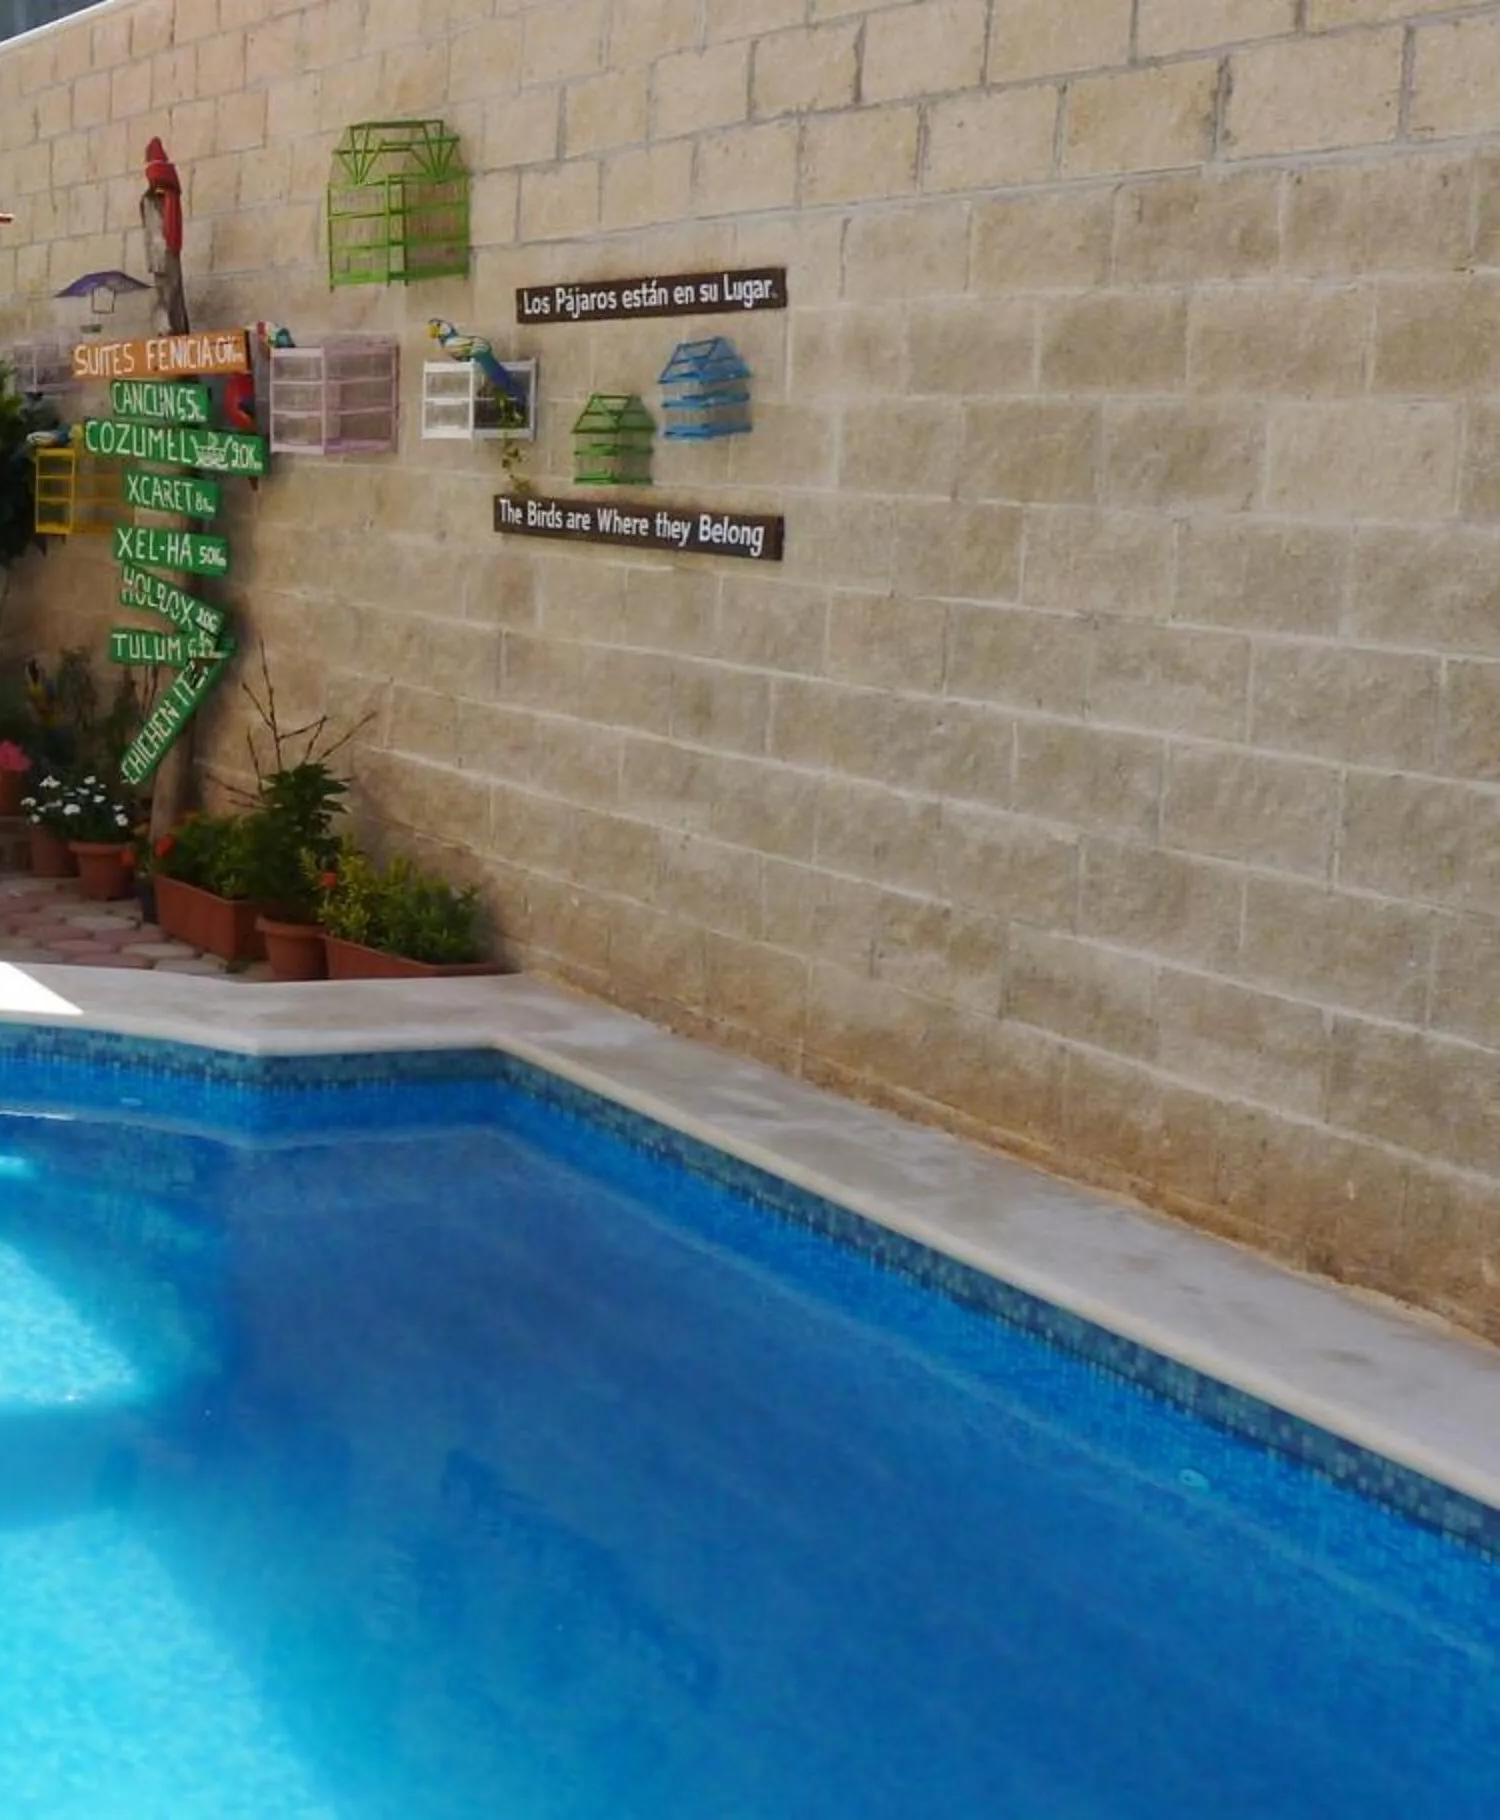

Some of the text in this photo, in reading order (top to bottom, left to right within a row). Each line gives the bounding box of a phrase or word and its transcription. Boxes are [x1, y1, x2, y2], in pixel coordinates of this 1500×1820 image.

[523, 290, 550, 315] Los
[554, 285, 617, 318] Pájaros
[621, 279, 669, 309] están
[673, 284, 695, 304] en
[699, 283, 718, 303] su
[73, 343, 136, 377] SUITES
[146, 337, 213, 371] FENICIA
[85, 420, 194, 465] COZUMEL
[126, 474, 194, 512] XCARET
[117, 527, 194, 567] XEL-HA
[500, 499, 766, 557] The Birds are Where they Belong
[121, 565, 196, 632] HOLBOX
[111, 633, 182, 661] TULUM
[119, 699, 181, 785] CHICHEN
